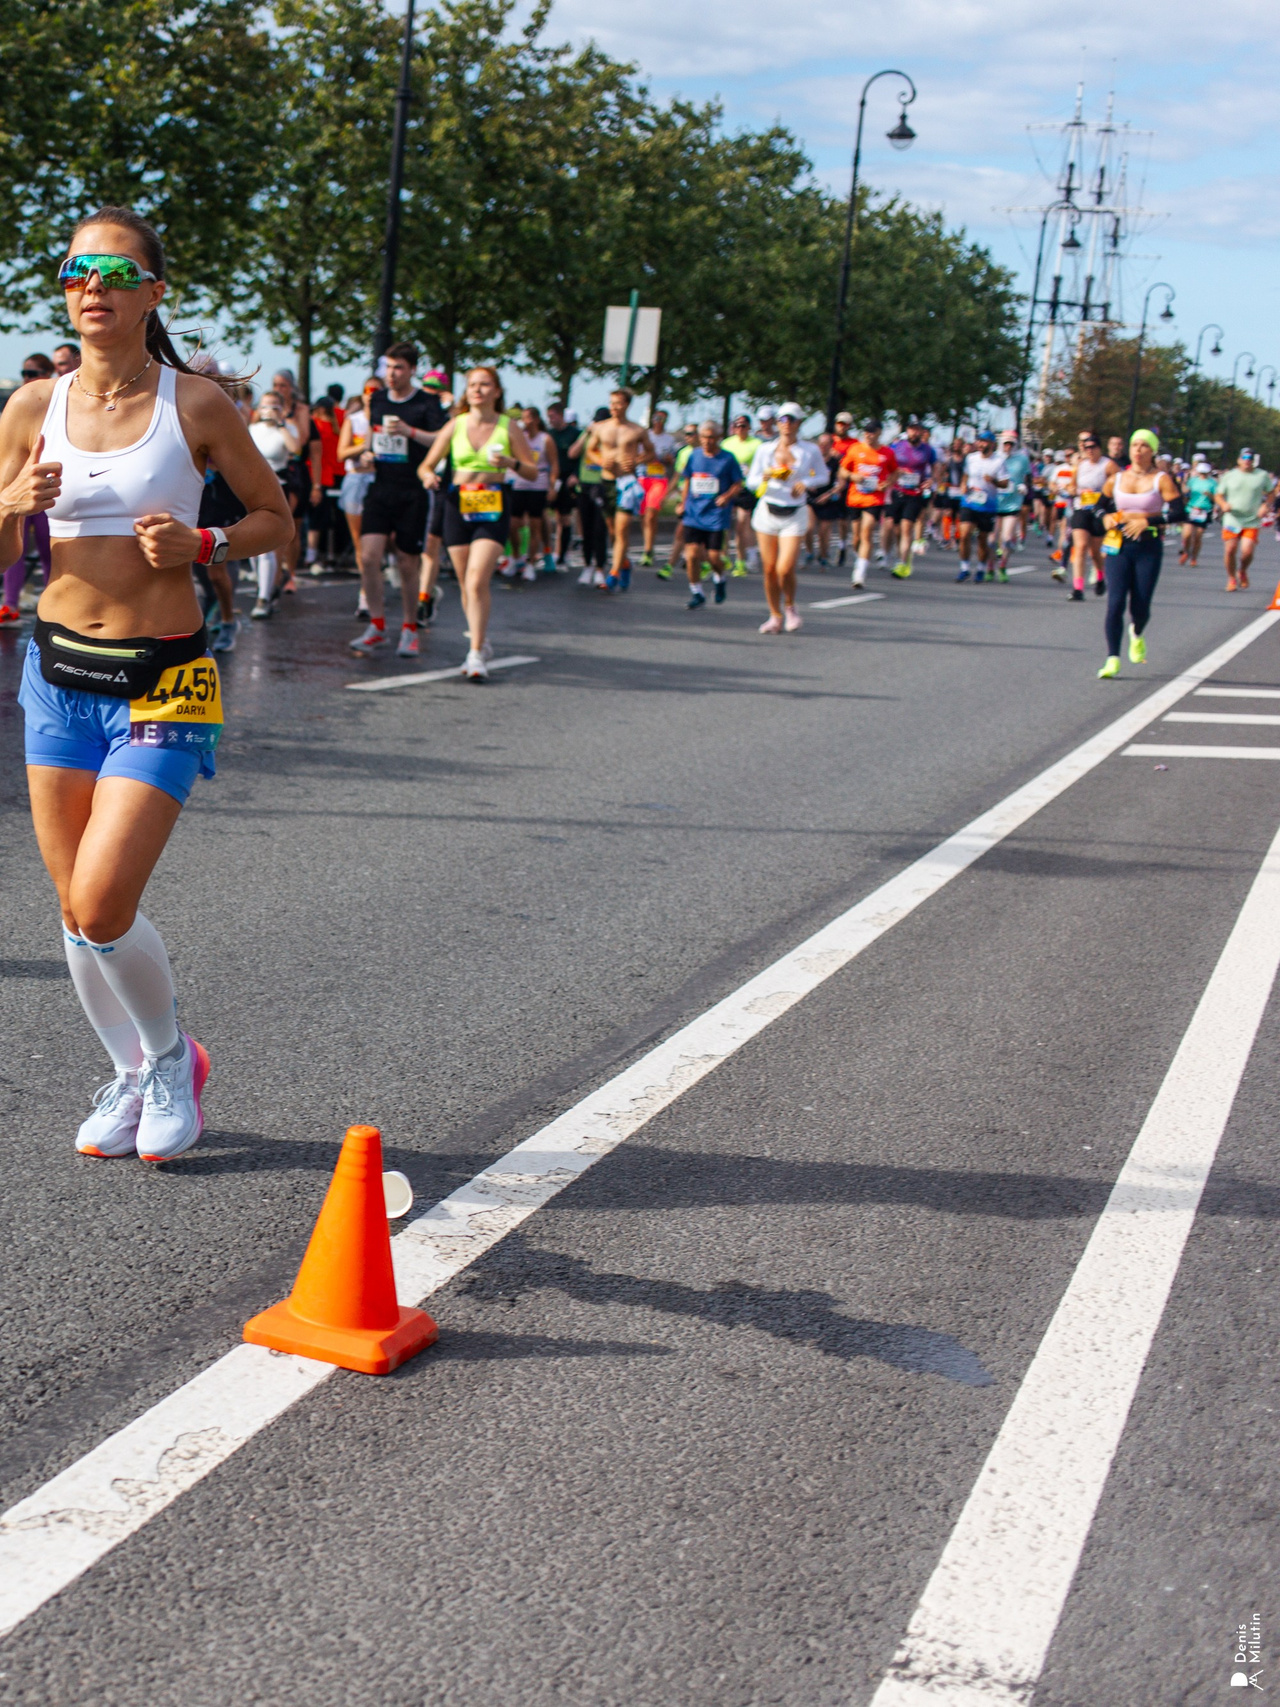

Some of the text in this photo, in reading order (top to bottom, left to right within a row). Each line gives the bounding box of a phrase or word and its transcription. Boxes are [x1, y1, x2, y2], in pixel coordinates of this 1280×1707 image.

[53, 662, 113, 681] FISCHER
[146, 666, 217, 704] 4459
[176, 705, 206, 715] DARYA
[143, 724, 158, 743] E
